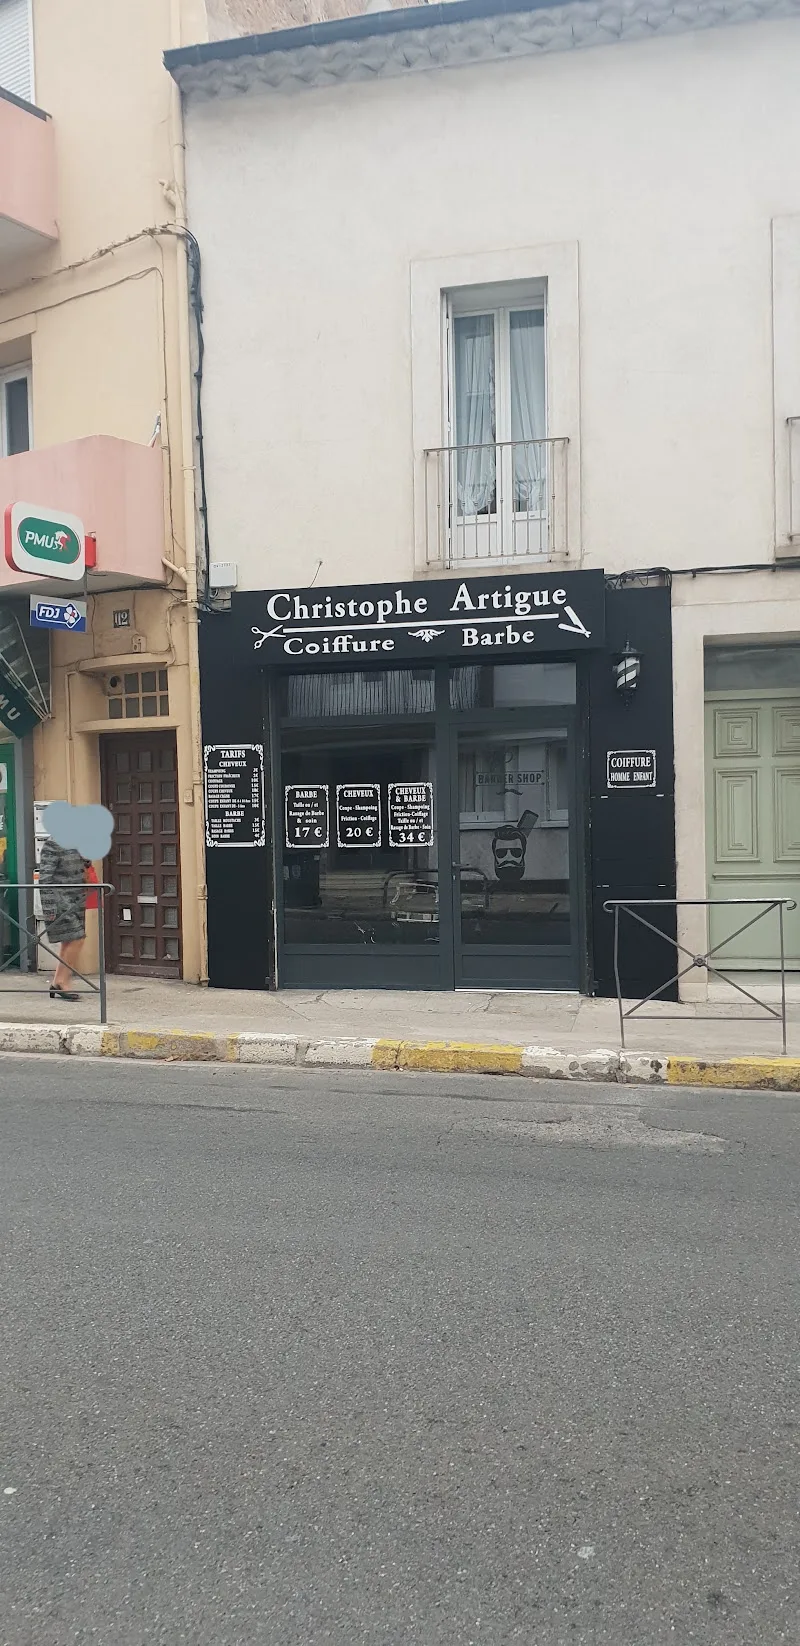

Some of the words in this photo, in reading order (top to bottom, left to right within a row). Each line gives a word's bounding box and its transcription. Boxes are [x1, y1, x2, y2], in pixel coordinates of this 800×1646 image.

[25, 531, 54, 548] PMU
[267, 589, 428, 623] Christophe
[450, 582, 566, 616] Artigue
[39, 606, 60, 618] FDJ
[114, 612, 128, 626] 112
[284, 634, 395, 654] Coiffure
[462, 624, 535, 646] Barbe
[220, 750, 246, 758] TARIFS
[611, 757, 651, 768] COIFFURE
[517, 773, 542, 783] SHOP
[610, 772, 630, 781] HOMME
[633, 772, 652, 781] ENFANT
[295, 827, 310, 838] 17
[314, 827, 322, 837] €
[346, 828, 362, 837] 20
[366, 827, 373, 836] €
[399, 832, 414, 842] 34
[418, 832, 425, 842] €
